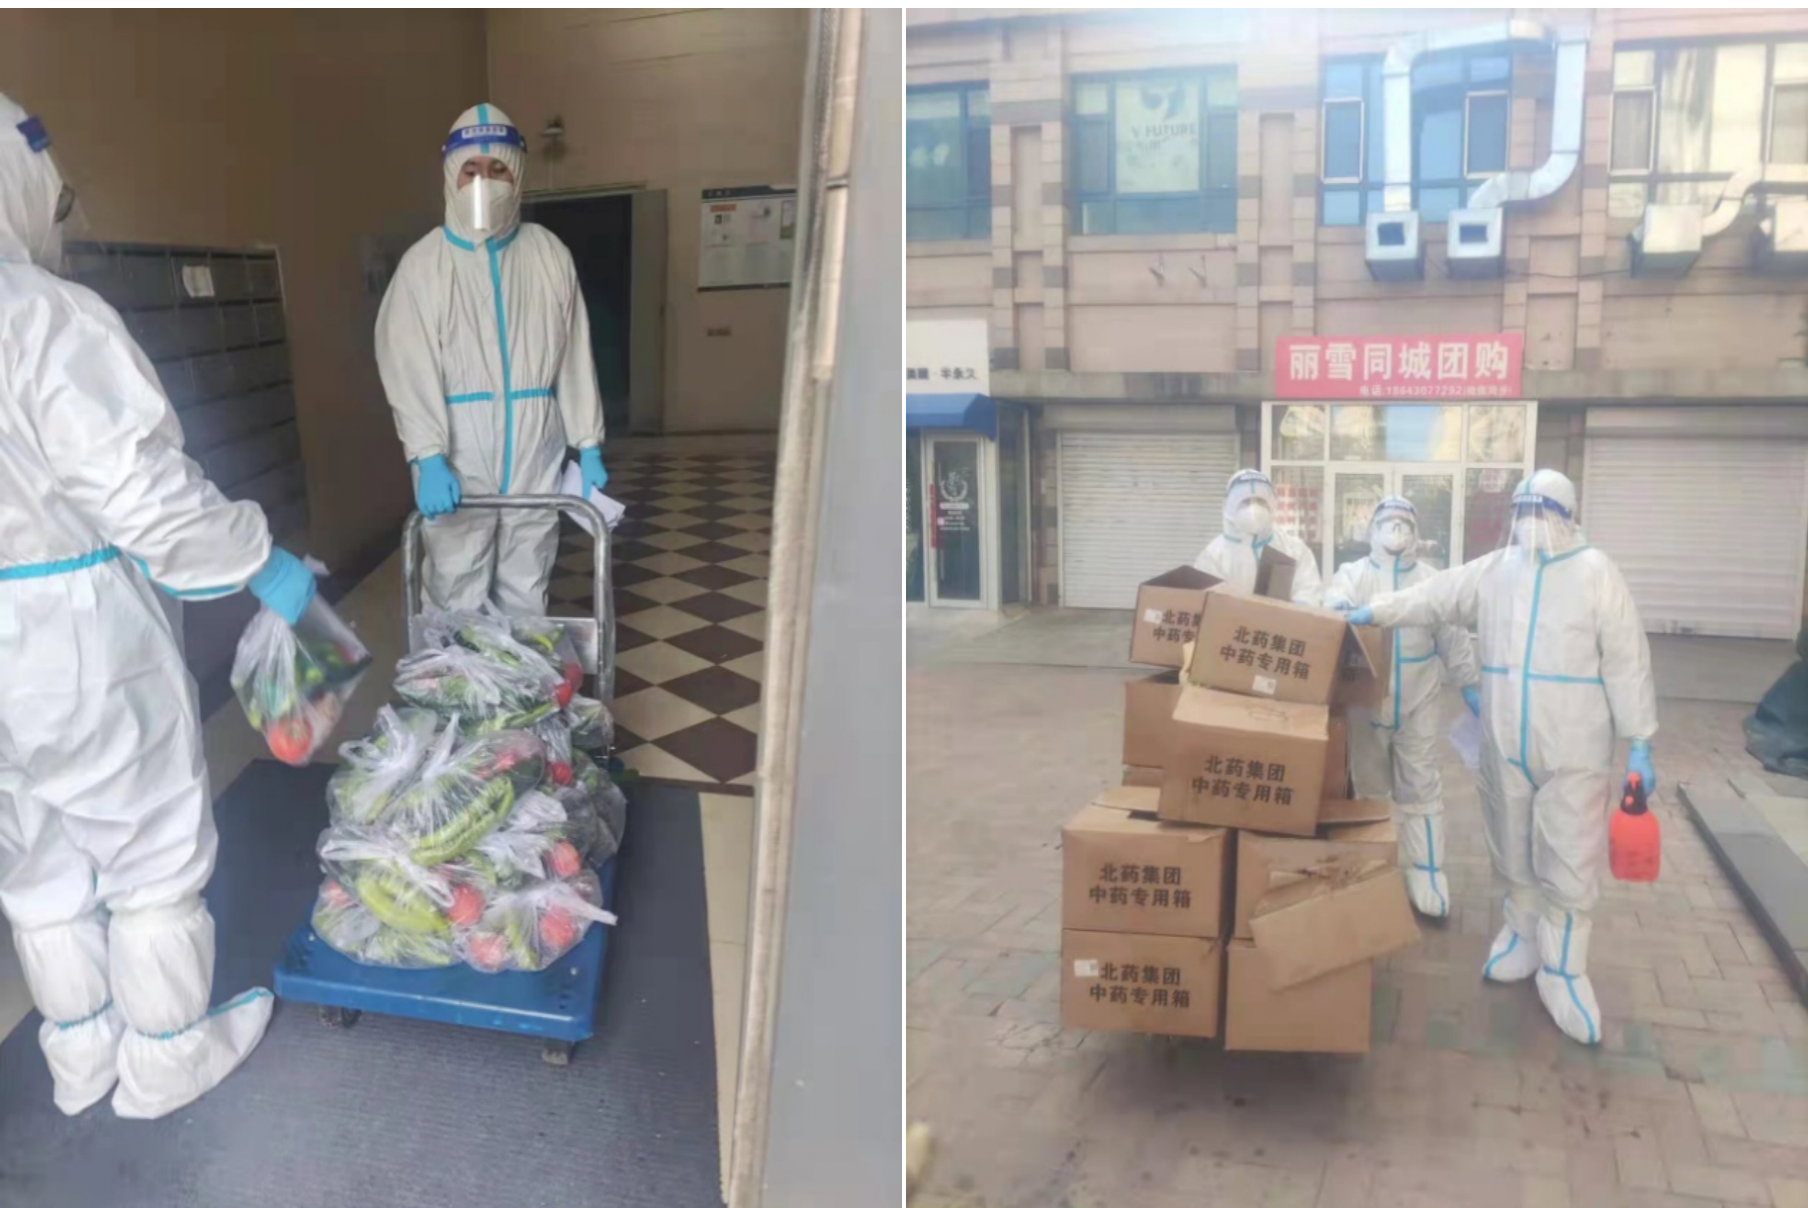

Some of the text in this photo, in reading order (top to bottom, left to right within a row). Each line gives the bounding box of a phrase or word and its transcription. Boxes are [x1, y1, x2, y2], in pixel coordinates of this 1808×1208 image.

[1289, 341, 1508, 380] 丽雪同城团购
[1234, 626, 1306, 657] 北药集团
[1220, 644, 1311, 680] 中药专用箱
[1204, 755, 1286, 783] 北药集团
[1191, 777, 1295, 806] 中药专用箱
[1100, 864, 1181, 885] 北药集团
[1089, 886, 1192, 910] 中药专用箱
[1100, 962, 1182, 986] 北药集团
[1089, 983, 1191, 1009] 中药专用箱
